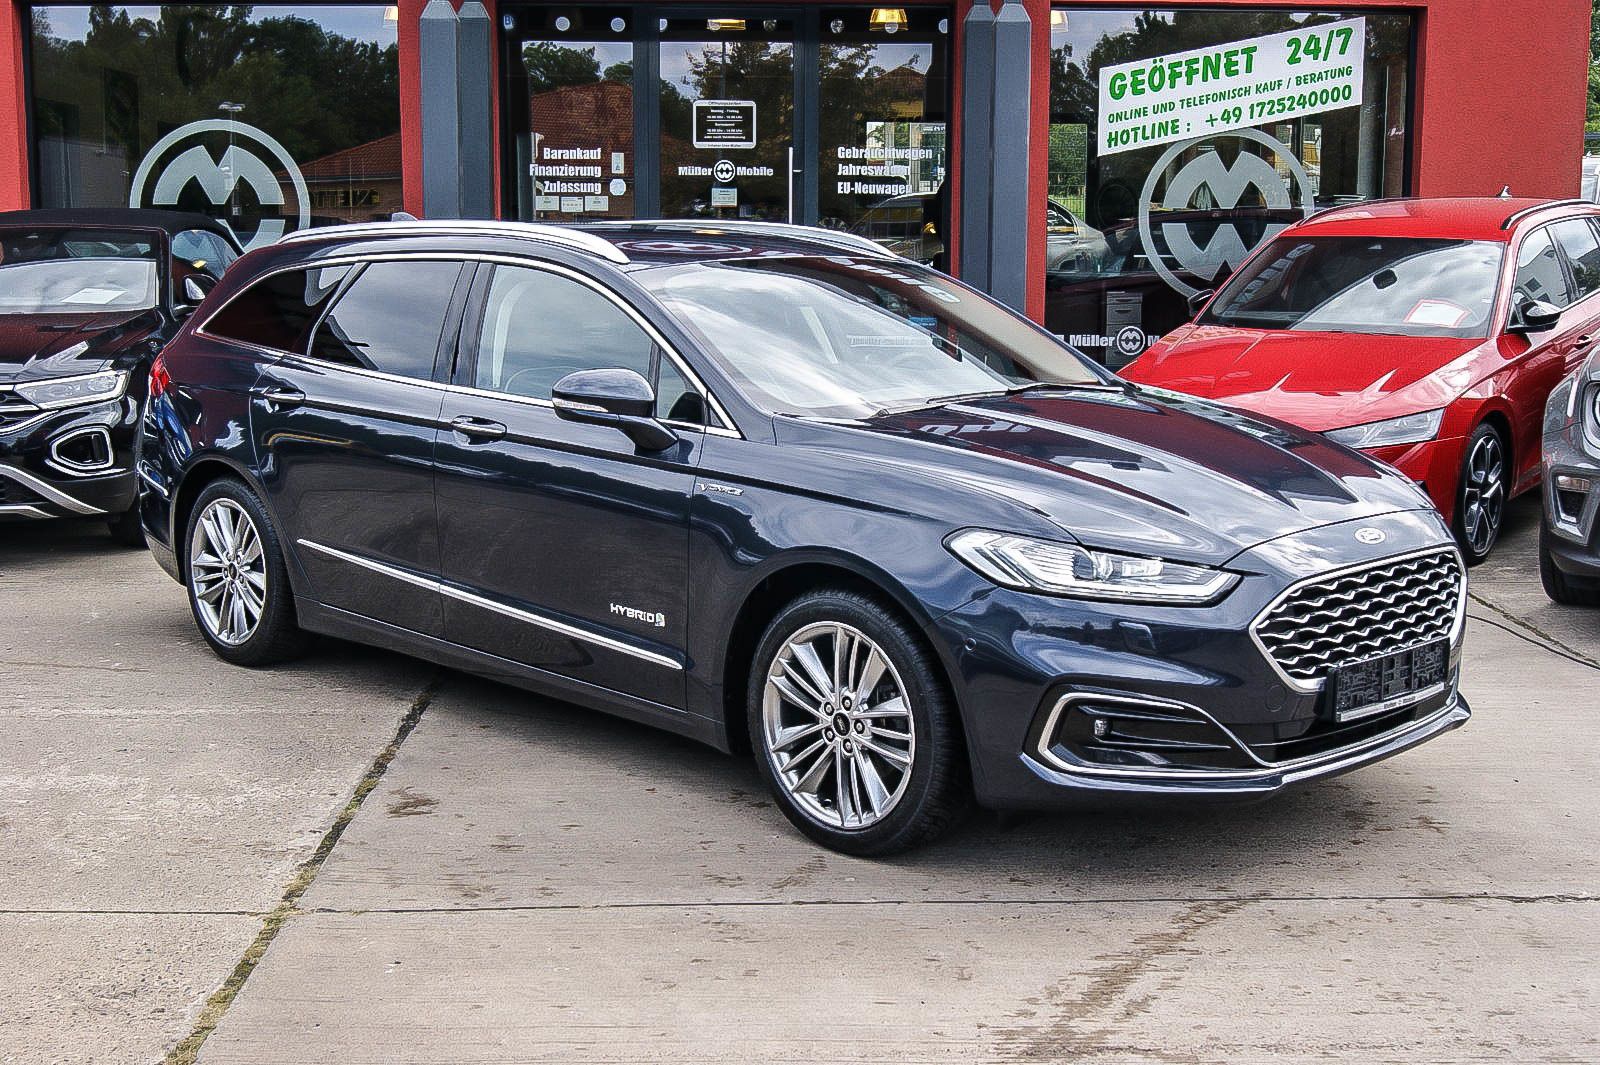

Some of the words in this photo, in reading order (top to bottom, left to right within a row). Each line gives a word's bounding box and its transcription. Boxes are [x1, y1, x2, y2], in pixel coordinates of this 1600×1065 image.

[1109, 45, 1258, 101] GEÖFFNET
[1286, 27, 1354, 66] 24/7
[1107, 106, 1149, 124] ONLINE
[1152, 101, 1176, 115] UND
[1180, 85, 1252, 110] TELEFONISCH
[1255, 79, 1283, 95] KAUF
[1295, 65, 1353, 87] BERATUNG
[1106, 118, 1180, 149] HOTLINE
[1205, 105, 1243, 128] +49
[1248, 84, 1353, 120] 1725240000
[543, 147, 602, 160] Barankauf
[837, 146, 933, 160] Gebrauchtwagen
[529, 163, 602, 178] Finanzierung
[678, 165, 713, 176] Müller
[736, 165, 774, 176] Mobile
[543, 180, 602, 195] Zulassung
[837, 181, 913, 195] EU-Neuwagen
[1069, 334, 1116, 347] Müller
[610, 602, 655, 623] HYBRID
